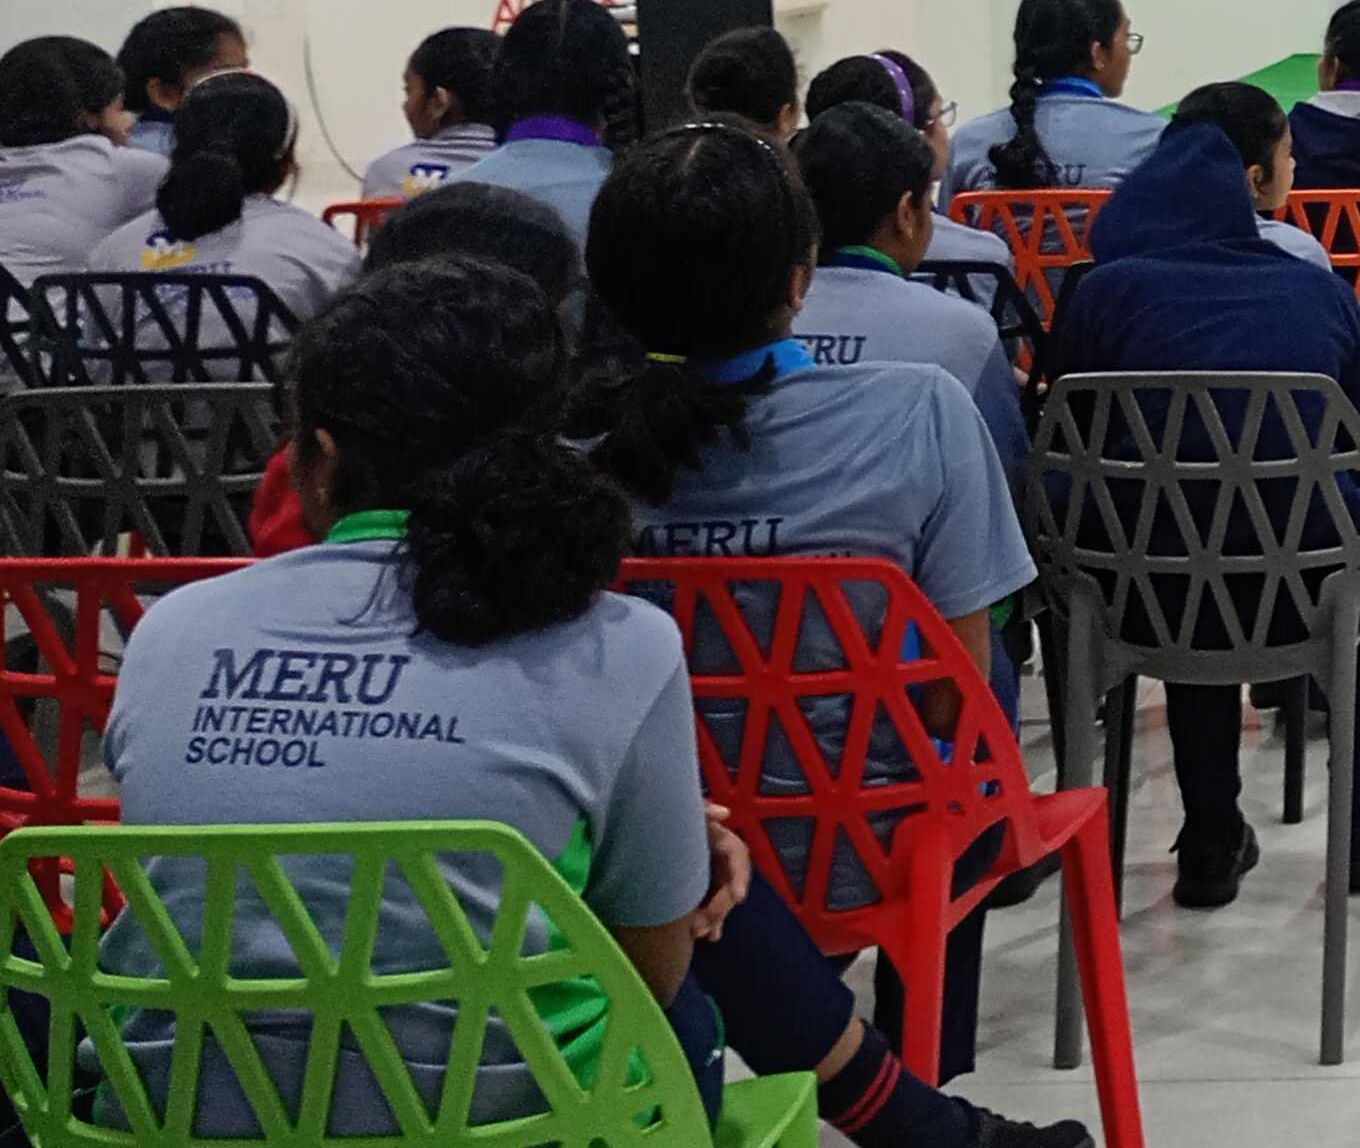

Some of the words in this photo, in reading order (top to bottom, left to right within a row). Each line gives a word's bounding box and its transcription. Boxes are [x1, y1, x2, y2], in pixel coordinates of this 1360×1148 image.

[199, 648, 411, 705] MERU
[192, 706, 466, 744] INTERNATIONAL
[184, 736, 326, 767] SCHOOL
